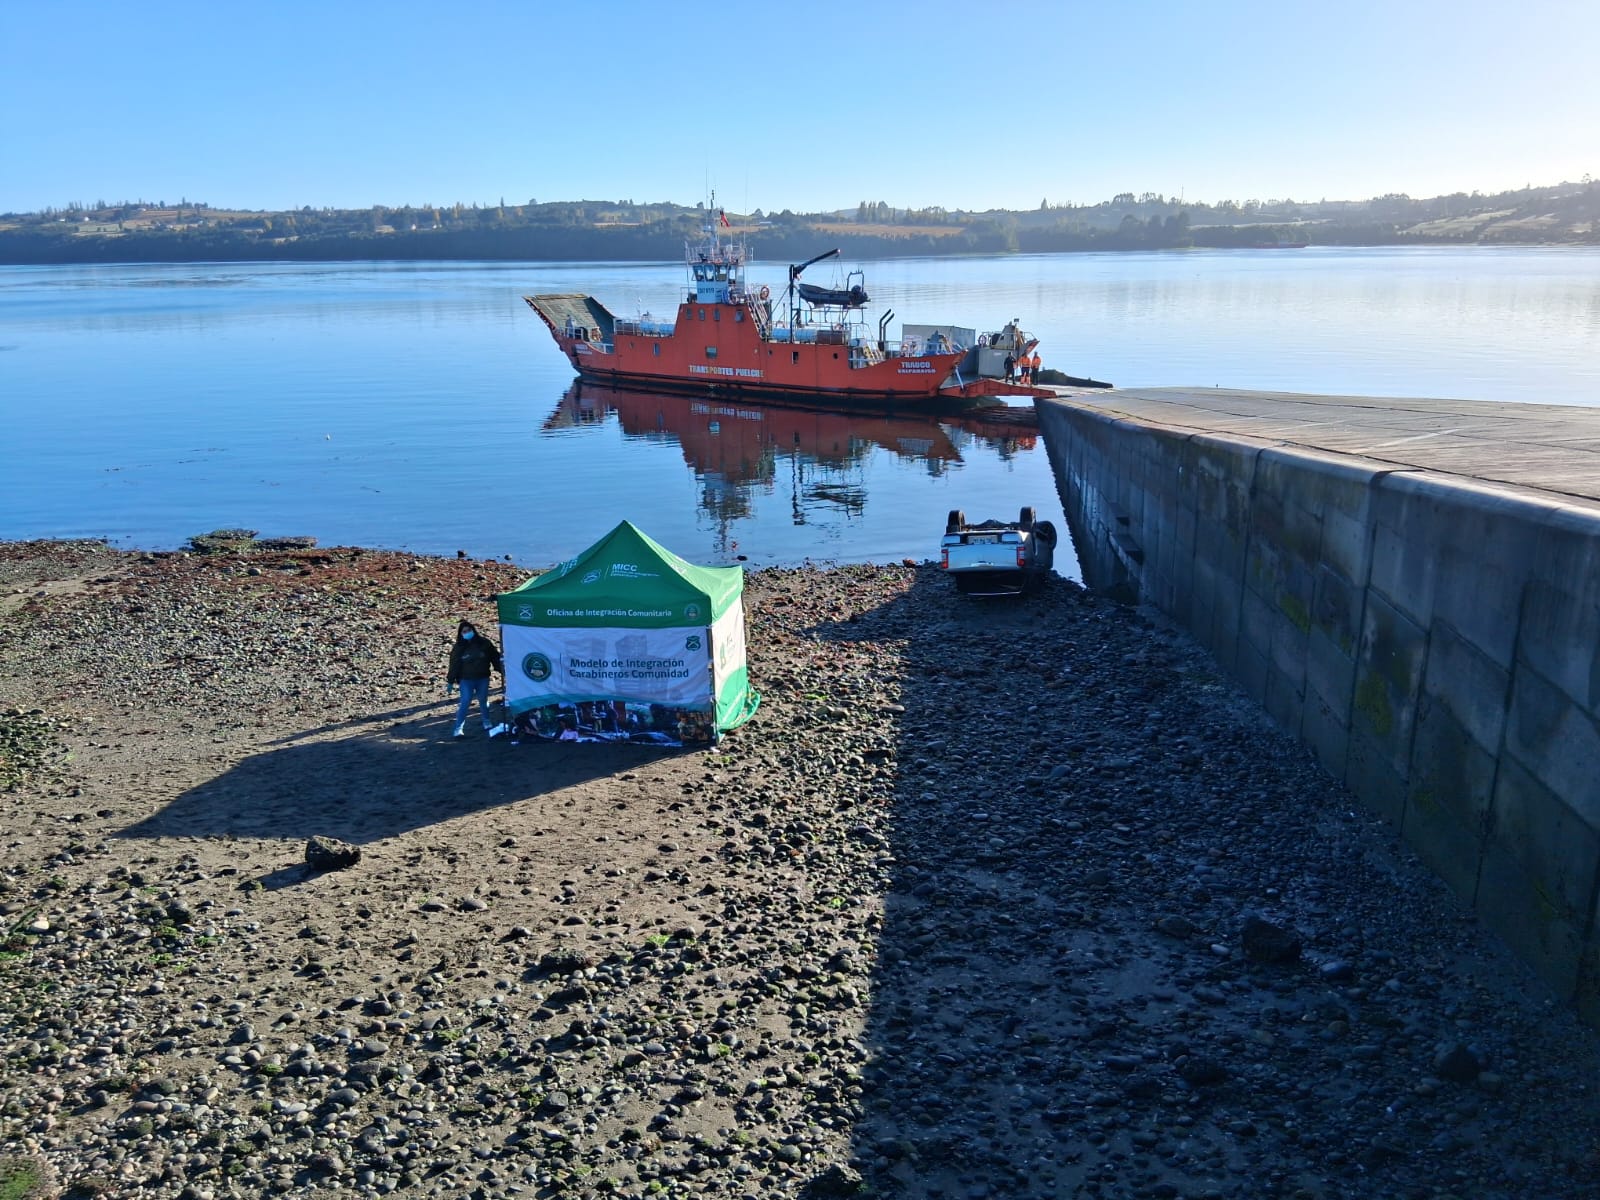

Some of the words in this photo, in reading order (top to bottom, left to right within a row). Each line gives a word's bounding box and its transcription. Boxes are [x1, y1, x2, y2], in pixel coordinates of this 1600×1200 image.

[612, 563, 638, 572] MICC
[547, 608, 573, 617] Oficina
[574, 608, 584, 617] de
[585, 608, 627, 617] Integración
[627, 608, 672, 617] Comunitaria
[570, 658, 609, 668] Modelo
[610, 658, 624, 668] de
[626, 658, 685, 670] Integración
[569, 669, 630, 679] Carabineros
[631, 668, 689, 679] Comunidad
